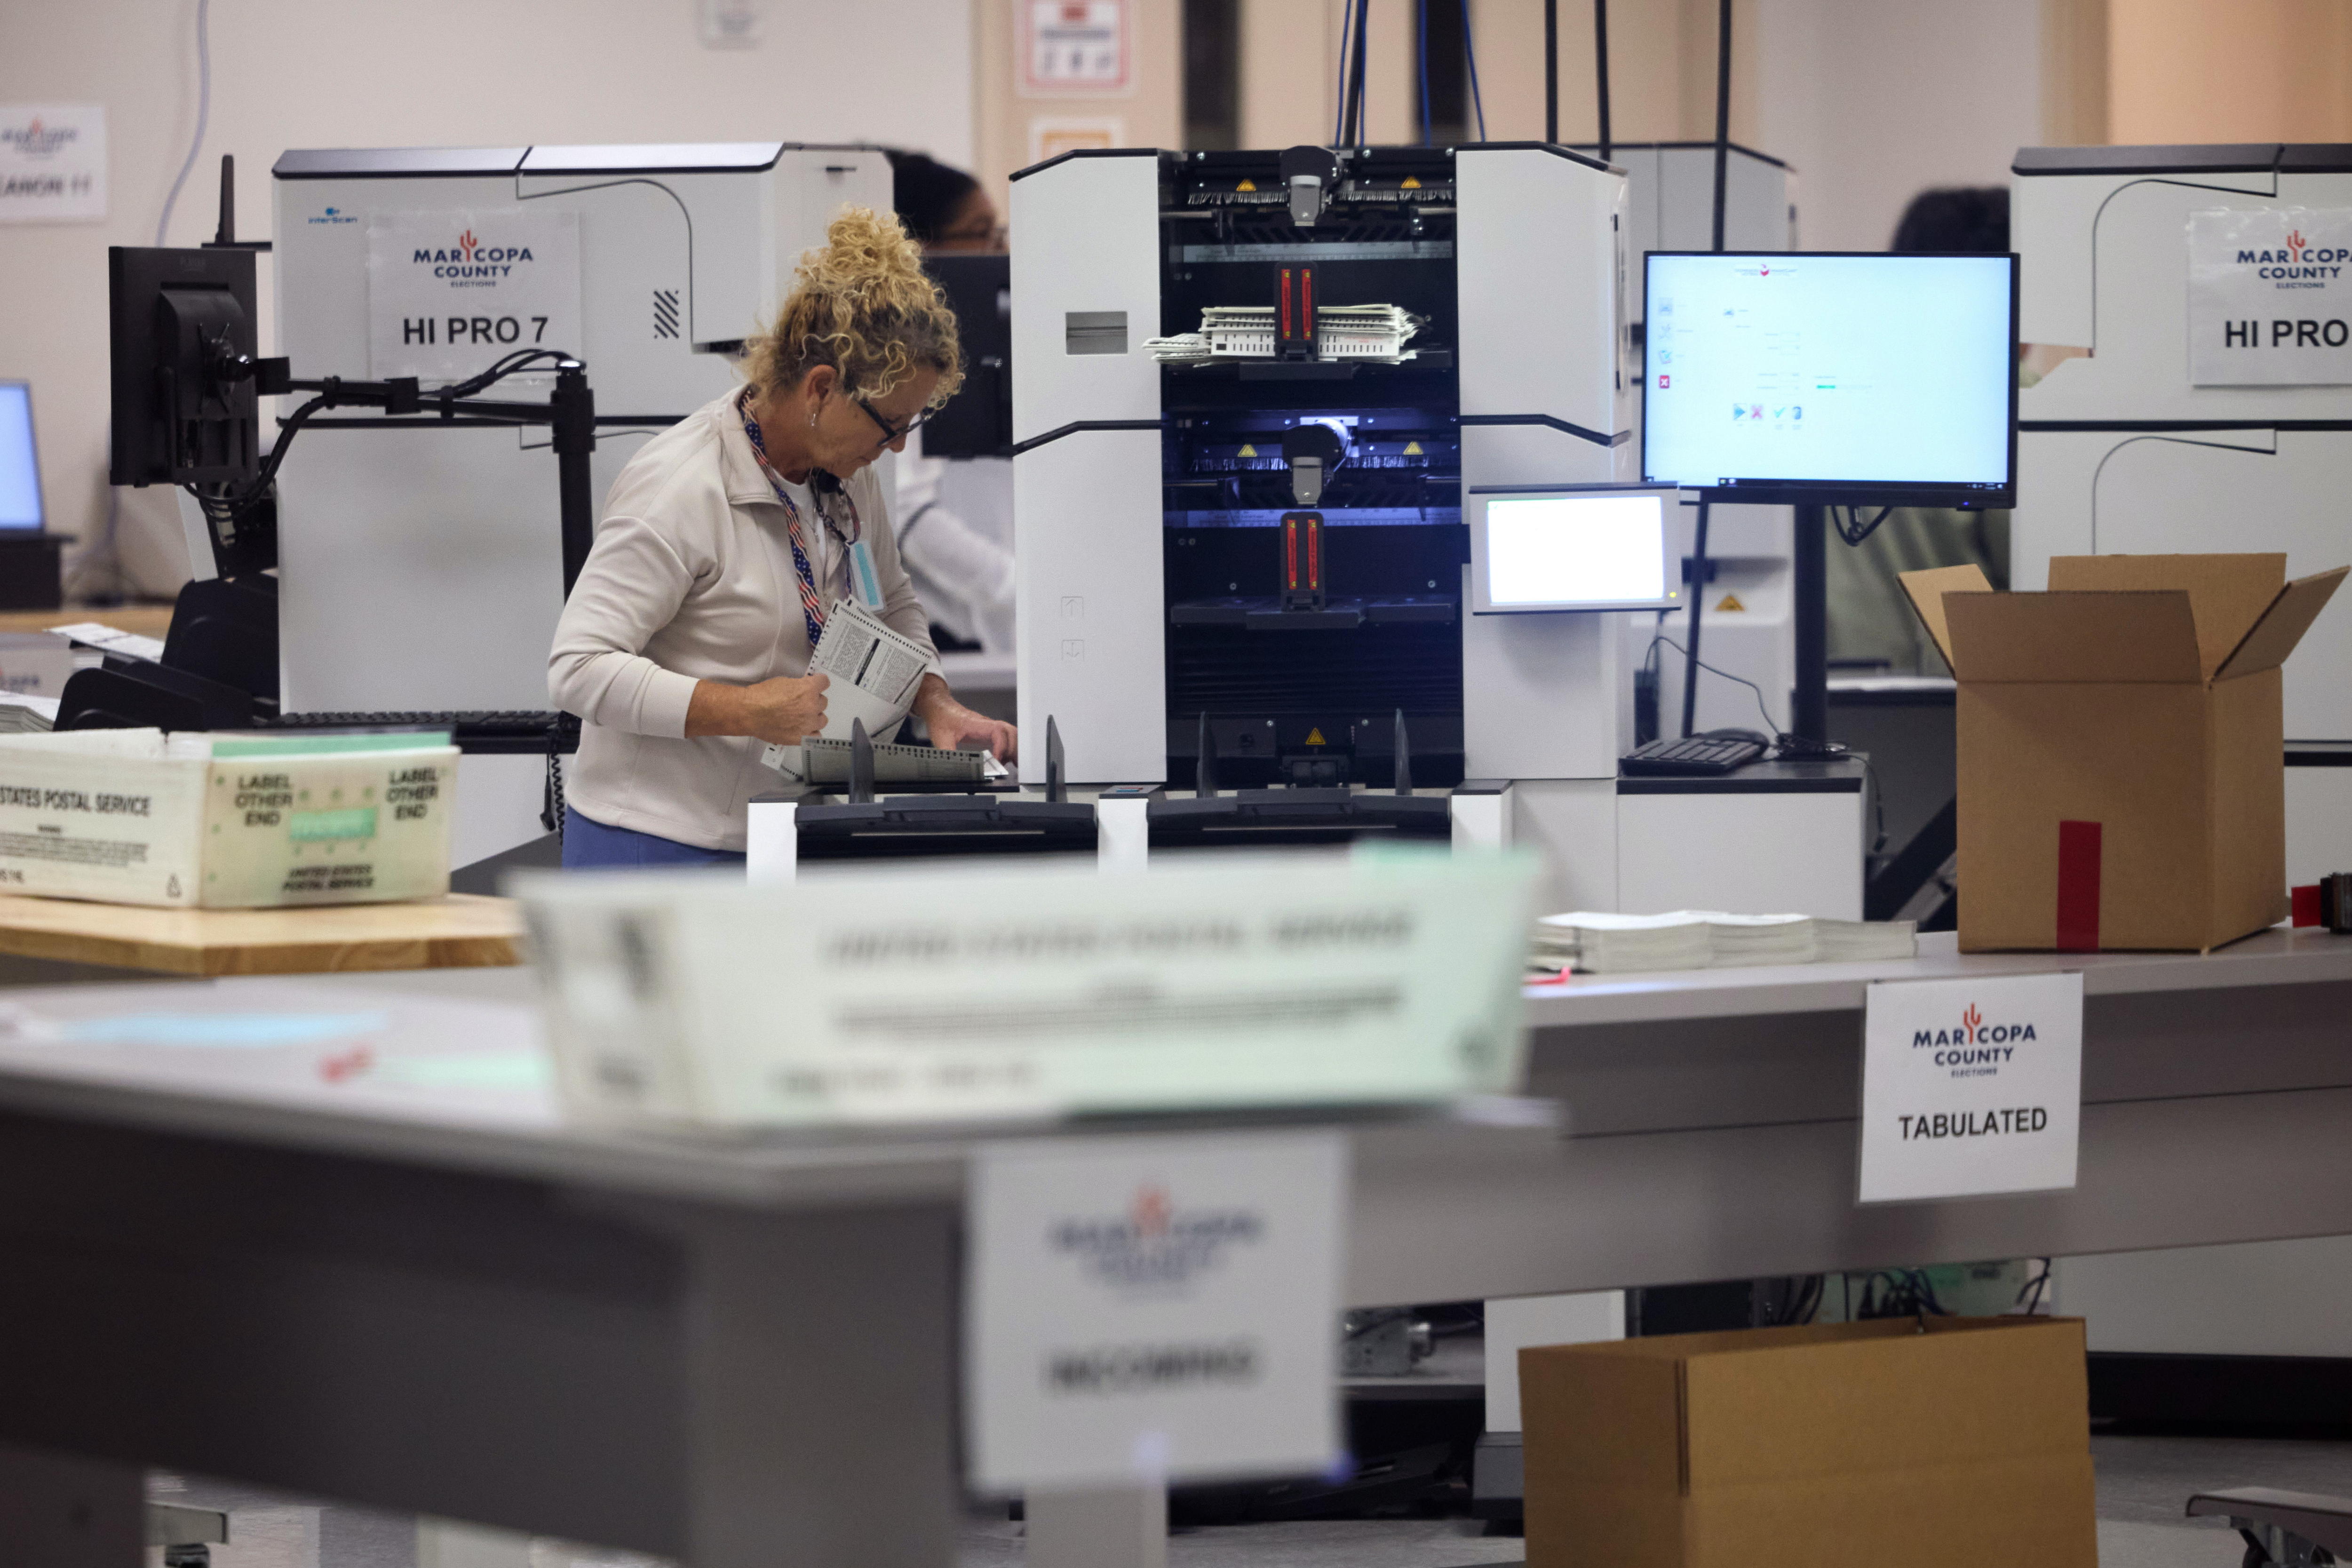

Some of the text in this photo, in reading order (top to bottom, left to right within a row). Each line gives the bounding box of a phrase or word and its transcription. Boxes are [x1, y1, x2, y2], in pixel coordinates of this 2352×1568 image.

[413, 239, 533, 263] MARICOPA
[2237, 240, 2352, 263] MARICOP
[434, 265, 512, 278] COUNTY
[2258, 267, 2342, 279] COUNTY
[403, 317, 549, 344] HI PRO 7
[2225, 319, 2349, 348] HI PRO
[238, 773, 291, 790] LABEL
[389, 767, 438, 784] LABEL
[45, 788, 91, 812] POSTAL
[96, 793, 151, 817] SERVICE
[235, 791, 293, 809] OTHER
[386, 784, 439, 803] OTHER
[245, 810, 281, 827] END
[395, 804, 428, 820] END
[1913, 1014, 2037, 1048] MARICOPA
[1934, 1047, 2014, 1066] COUNTY
[1950, 1067, 1998, 1078] ELECTIONS
[1899, 1107, 2047, 1140] TABULATED
